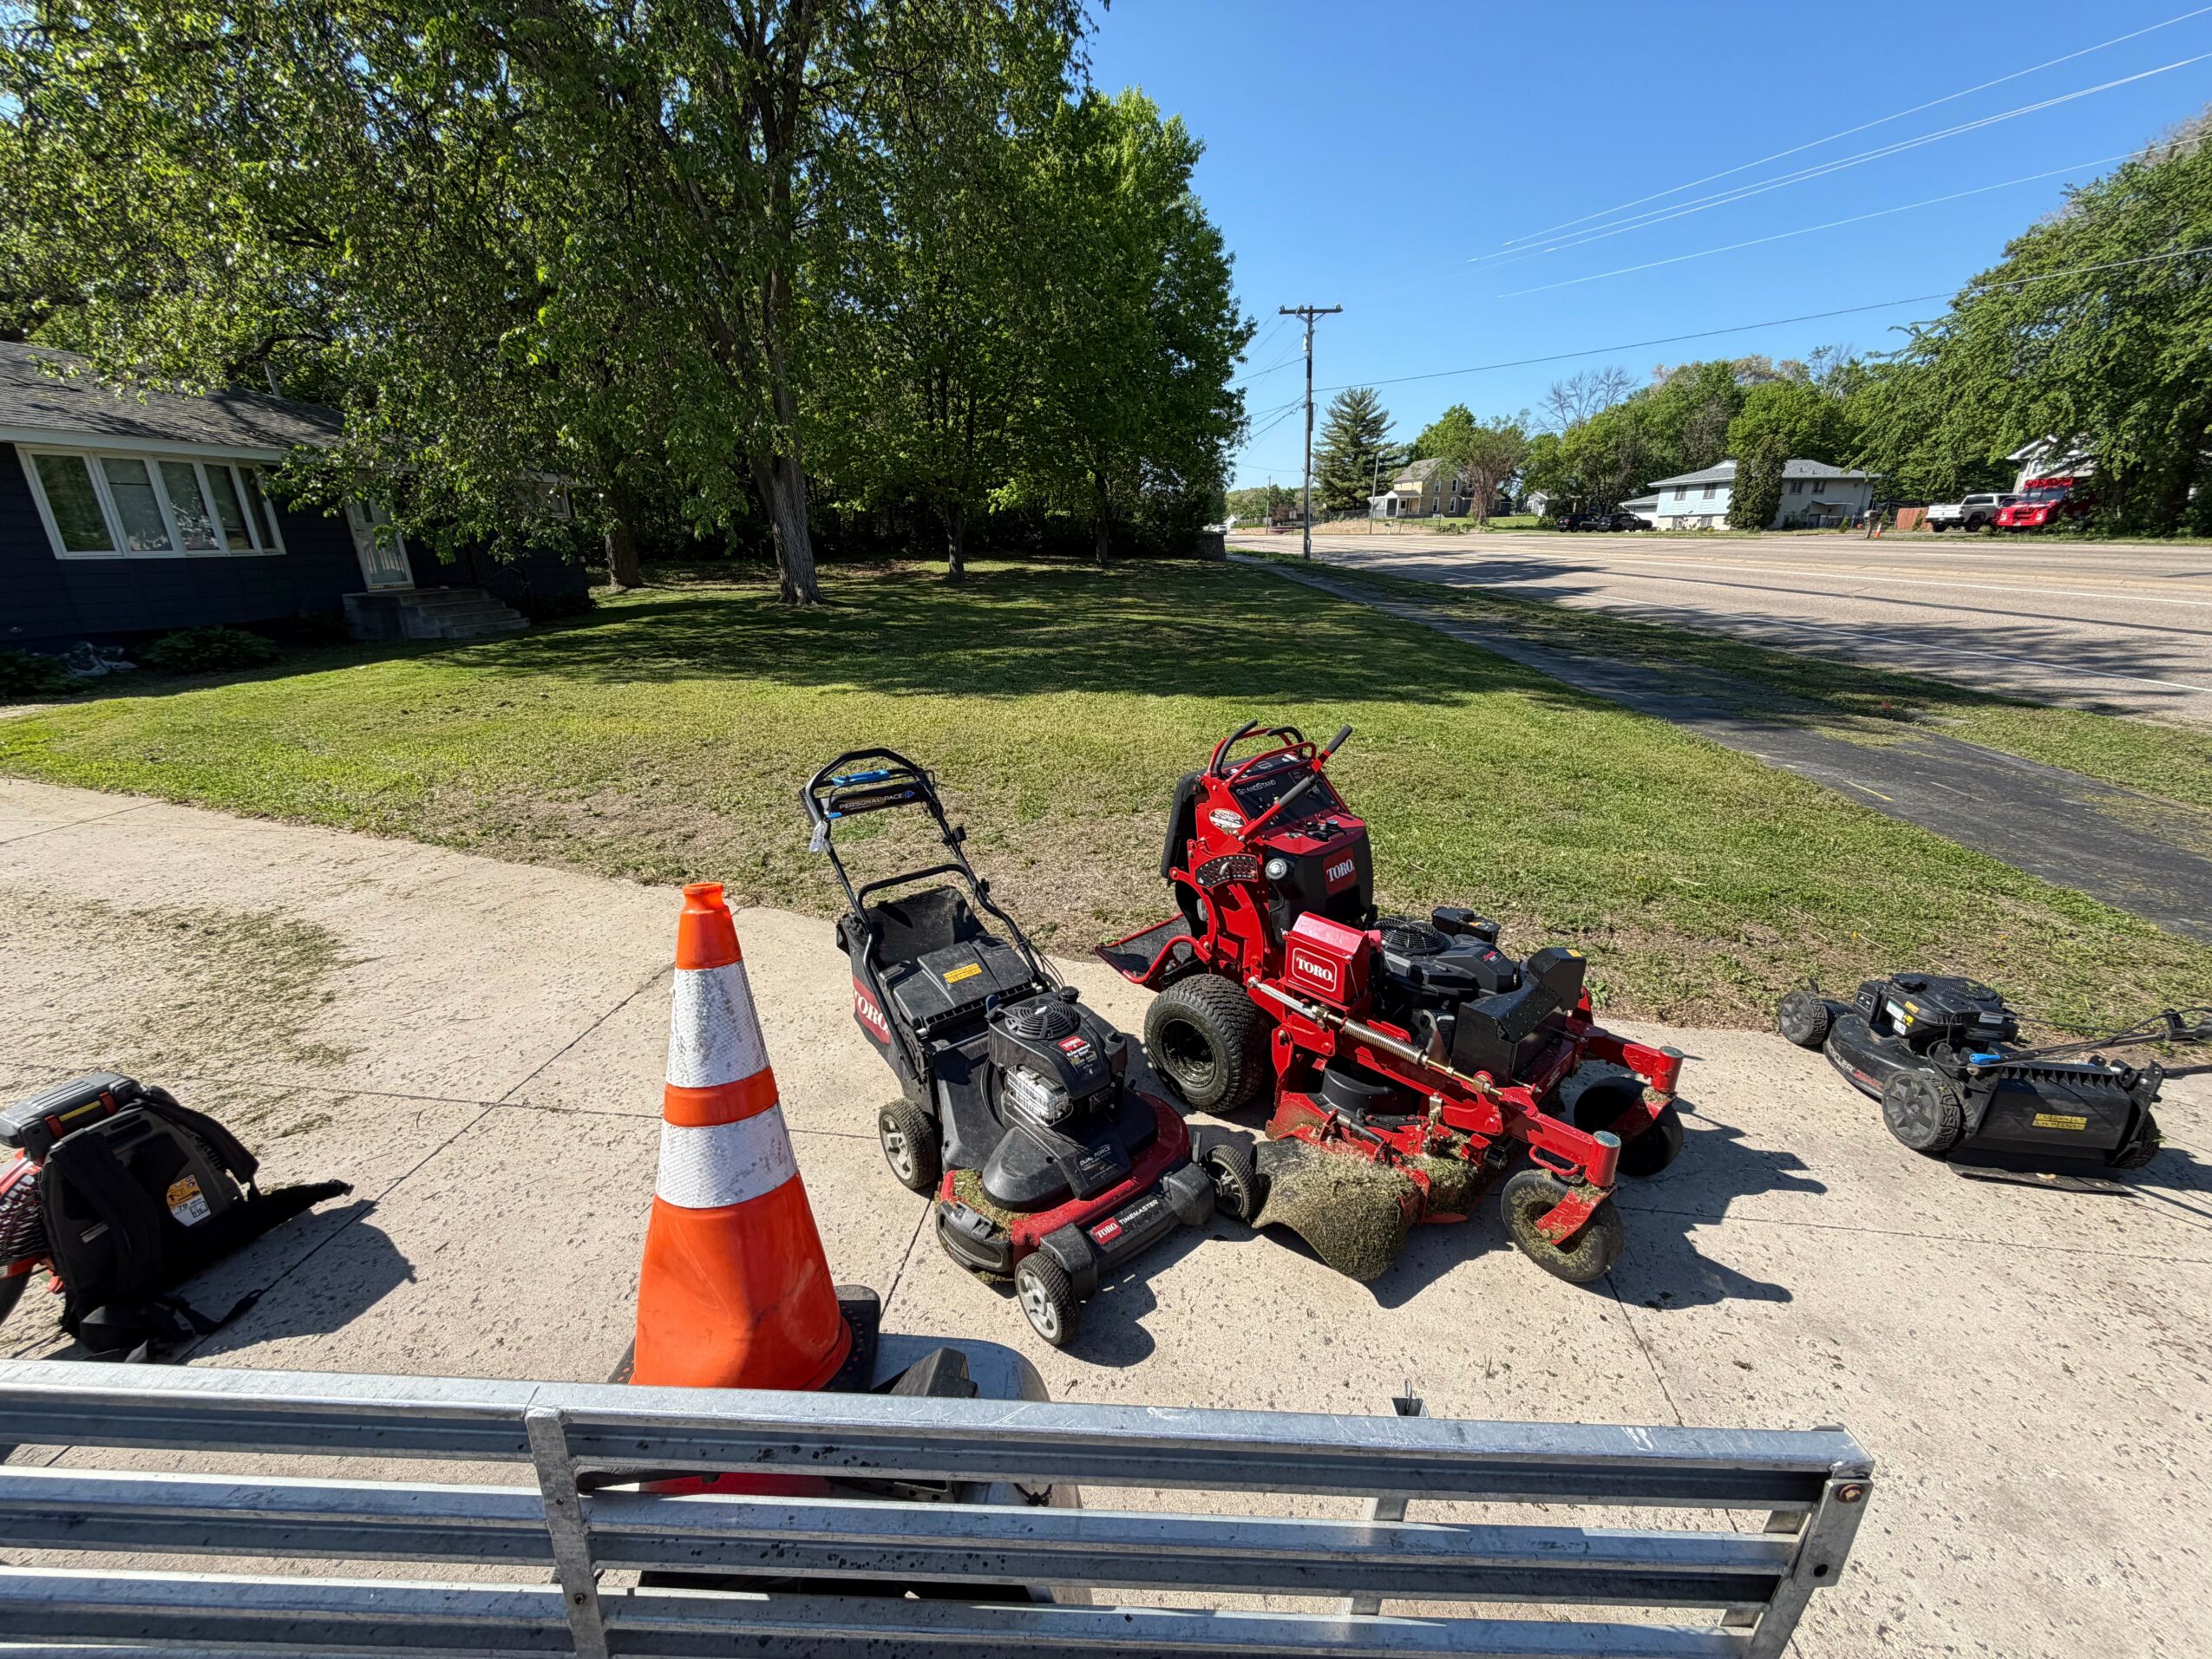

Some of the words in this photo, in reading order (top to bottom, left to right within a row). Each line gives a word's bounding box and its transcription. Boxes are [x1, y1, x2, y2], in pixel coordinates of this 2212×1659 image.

[839, 797, 880, 810] PERSONAL
[884, 793, 903, 801] PACE
[1326, 859, 1354, 883] TORO
[1296, 957, 1334, 983] TORO
[1079, 1156, 1094, 1166] DUAL
[1094, 1145, 1111, 1159] FORCE
[1095, 1222, 1118, 1239] TORO
[1119, 1199, 1159, 1225] TIMEMASTER
